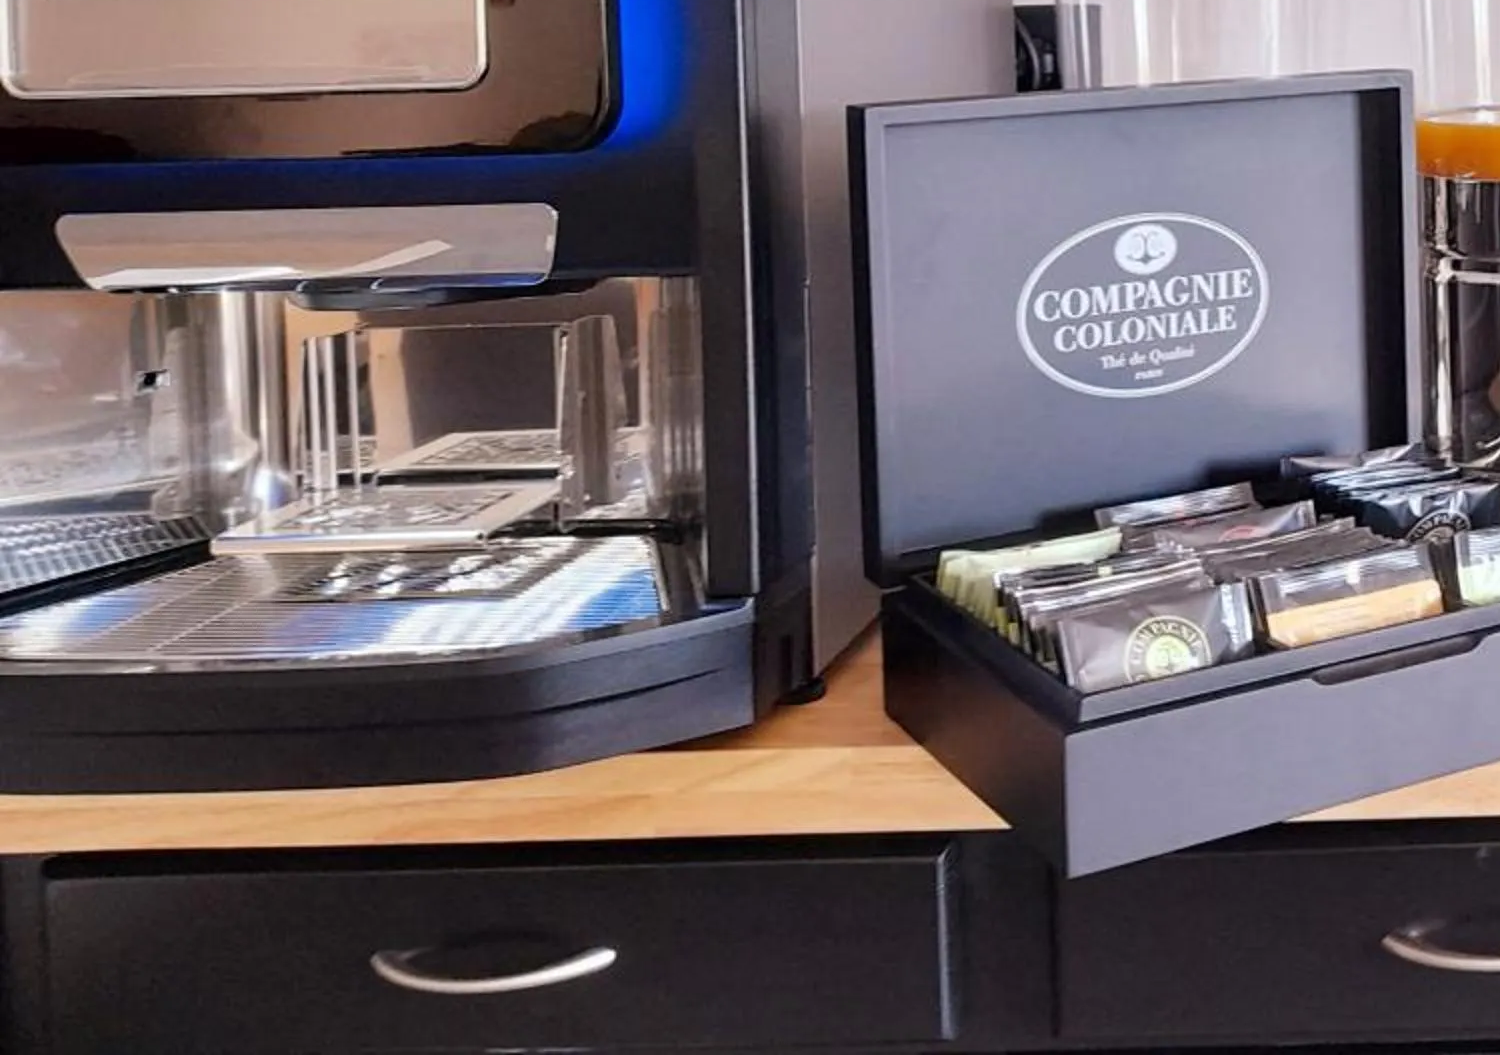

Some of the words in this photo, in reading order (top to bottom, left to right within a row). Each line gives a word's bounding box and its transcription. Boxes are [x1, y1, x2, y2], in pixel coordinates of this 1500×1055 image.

[1033, 268, 1253, 323] COMPAGNIE
[1053, 305, 1238, 353] COLONIALE
[1099, 352, 1126, 370] Thé
[1128, 350, 1148, 366] de
